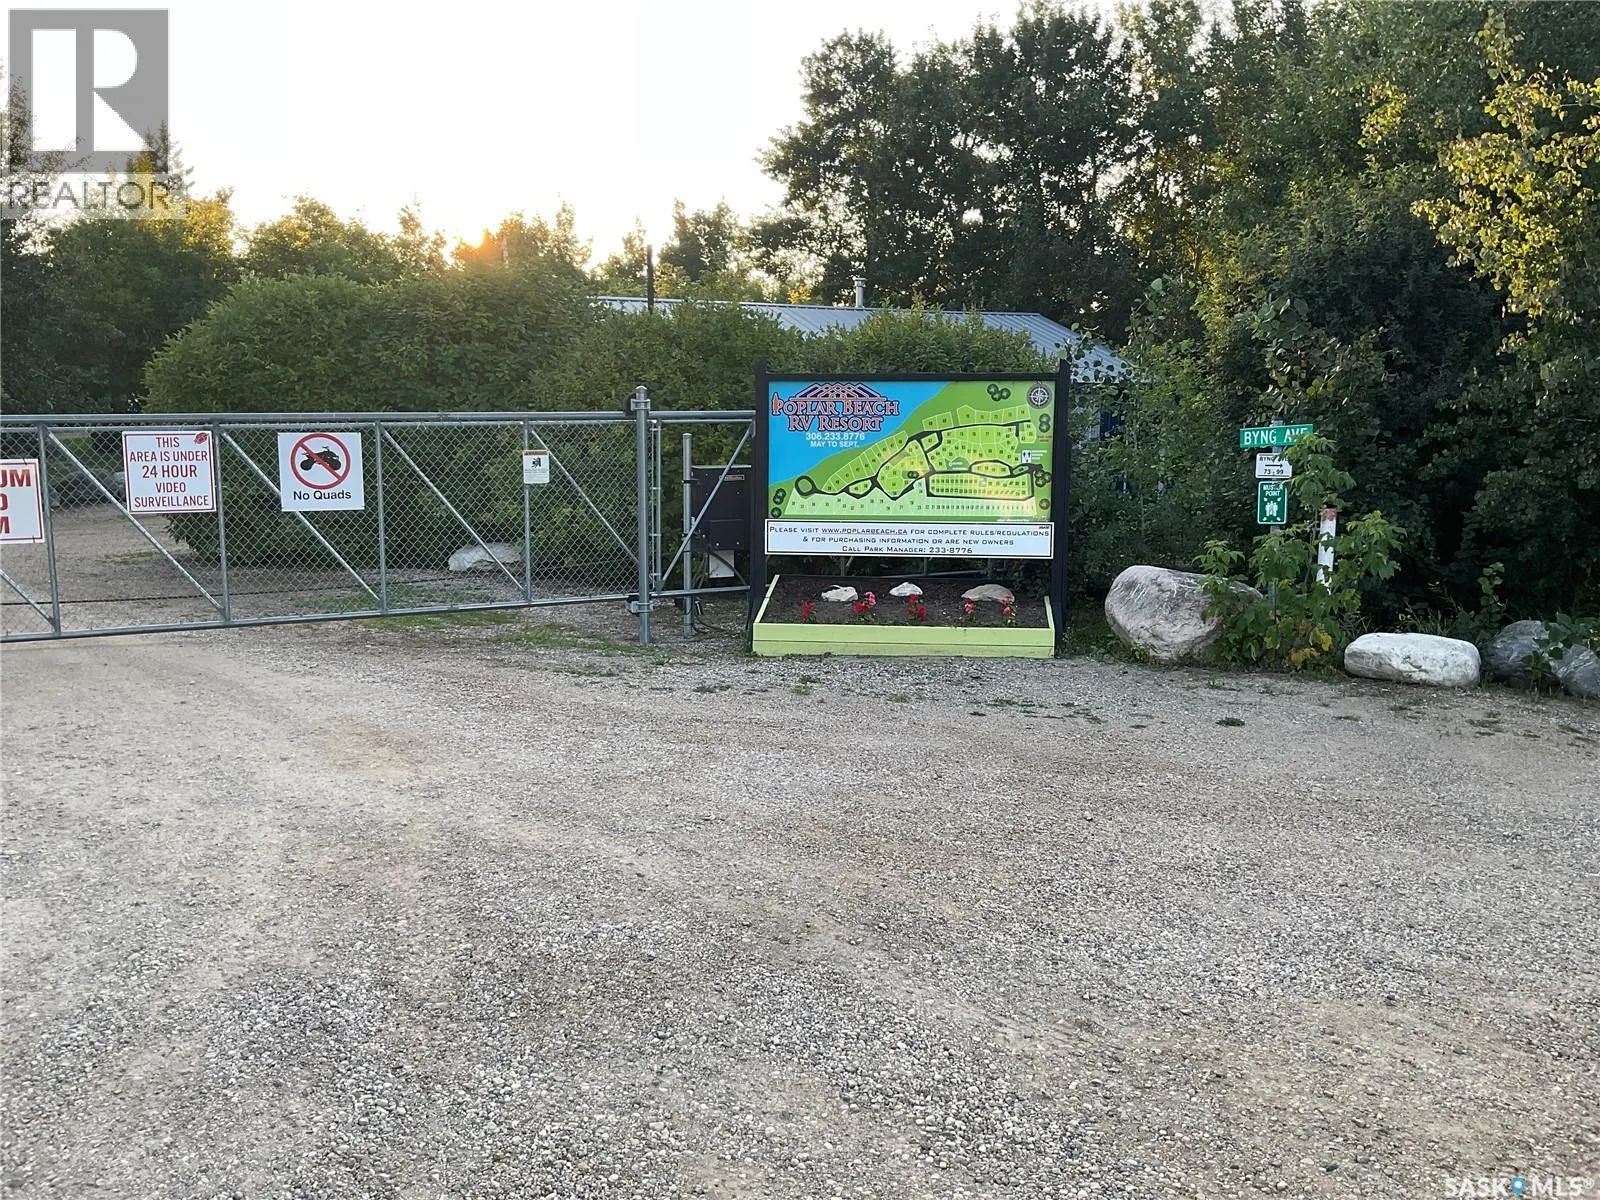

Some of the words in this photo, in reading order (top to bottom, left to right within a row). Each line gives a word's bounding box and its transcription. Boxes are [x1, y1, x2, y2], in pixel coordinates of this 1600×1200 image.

[773, 393, 839, 415] POPLAR
[842, 400, 900, 416] BEACH
[788, 414, 815, 432] RV
[818, 415, 884, 432] RESORT
[156, 436, 180, 448] THIS
[806, 432, 865, 441] 306.233.8776
[1244, 430, 1277, 445] BYNG
[130, 451, 157, 462] AREA
[160, 451, 170, 461] IS
[173, 450, 208, 462] UNDER
[142, 465, 157, 478] 24
[162, 464, 197, 478] HOUR
[155, 482, 186, 493] VIDEO
[293, 490, 310, 500] No
[313, 489, 352, 500] Quads
[134, 495, 209, 508] SURVEILLANCE
